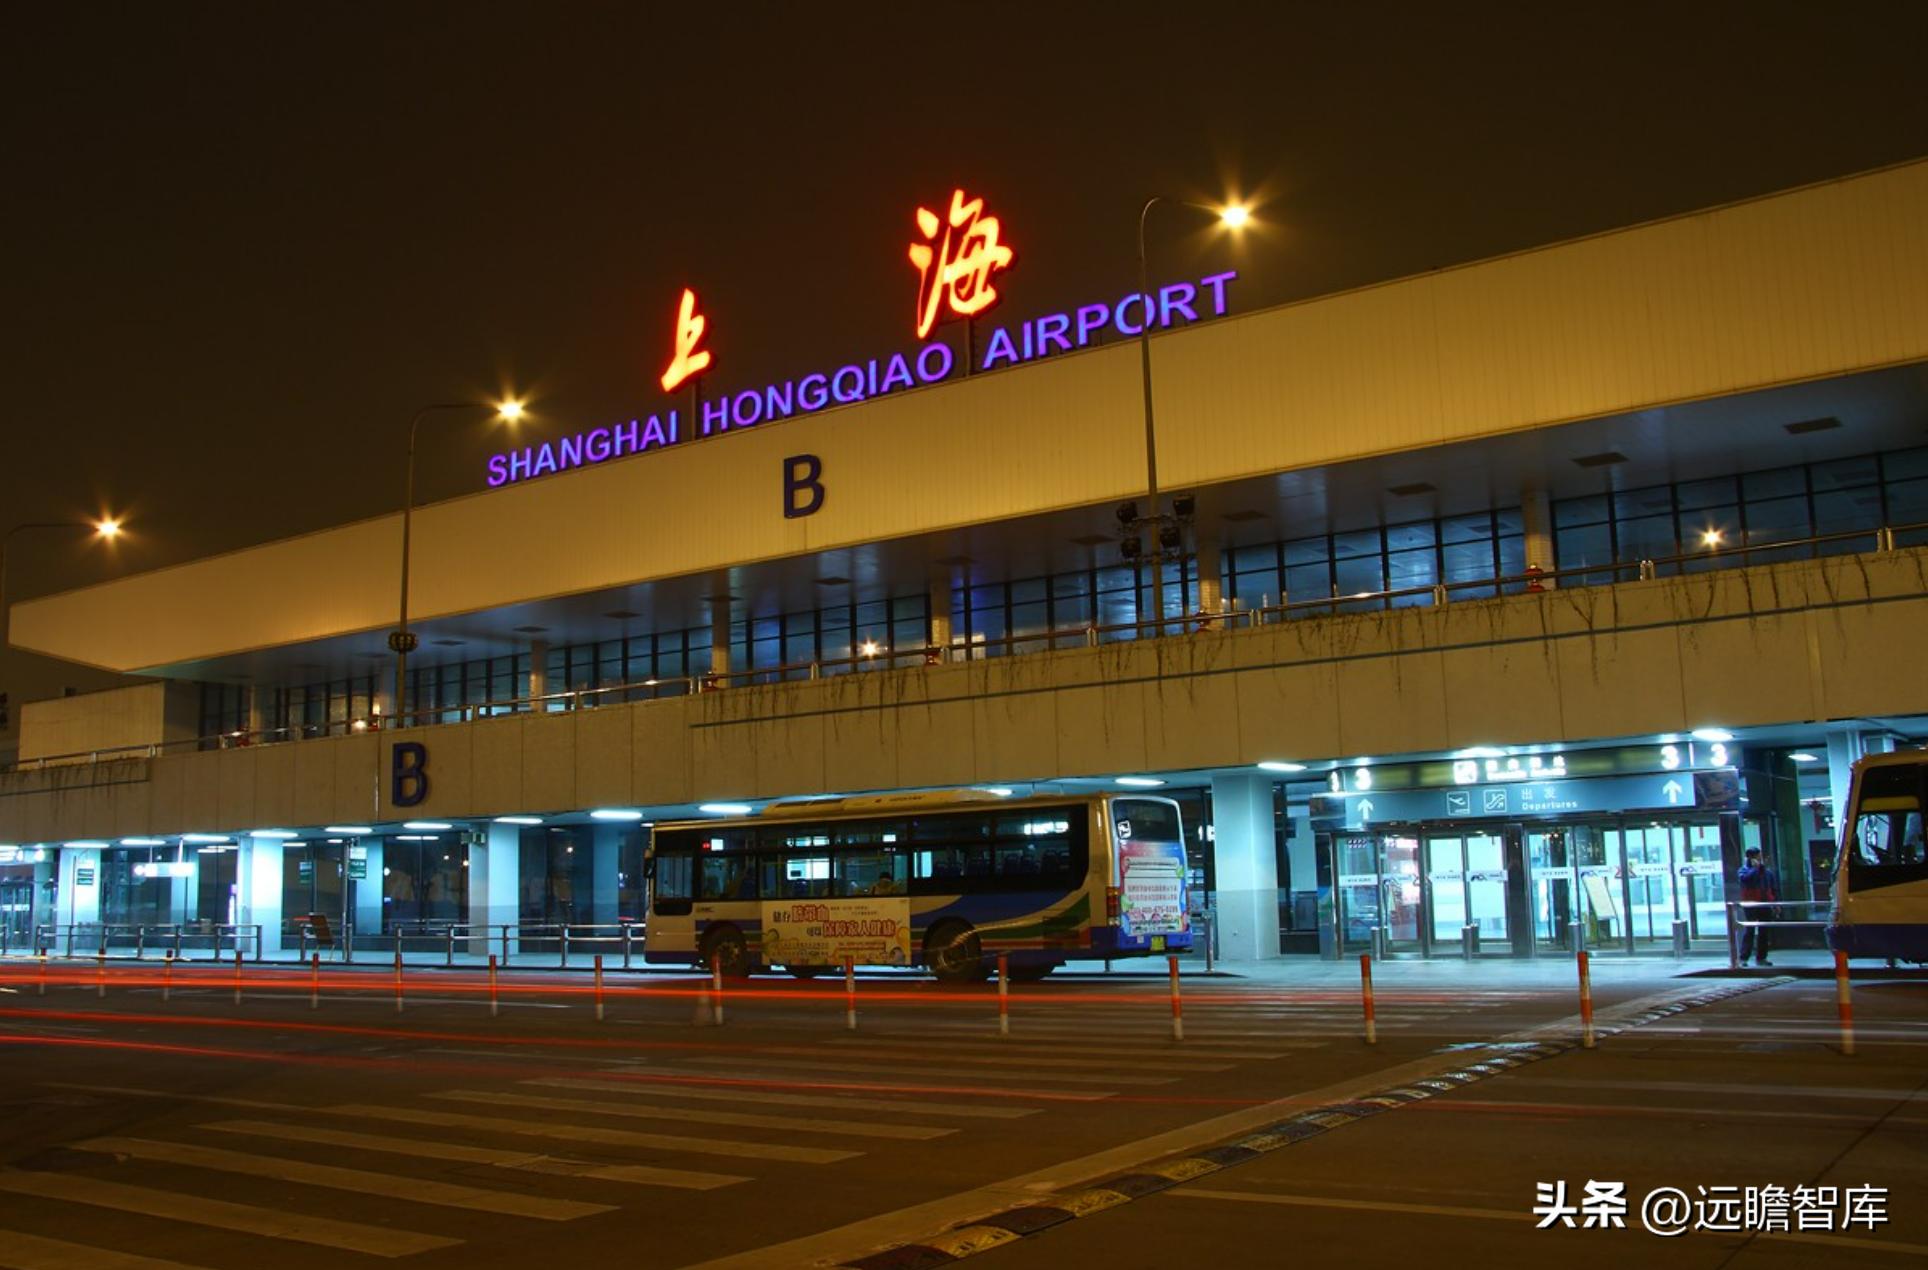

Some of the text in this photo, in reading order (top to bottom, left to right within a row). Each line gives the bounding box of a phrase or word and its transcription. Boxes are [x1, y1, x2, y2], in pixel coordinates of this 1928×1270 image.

[486, 270, 1238, 487] SHANGHAI HONGQIAO AIRPORT
[783, 454, 825, 519] B
[1661, 745, 1680, 769] 3
[1710, 743, 1728, 766] 3
[392, 742, 428, 807] B
[1355, 767, 1372, 790] 3
[1521, 786, 1556, 800] 出发
[1521, 801, 1578, 811] Departures
